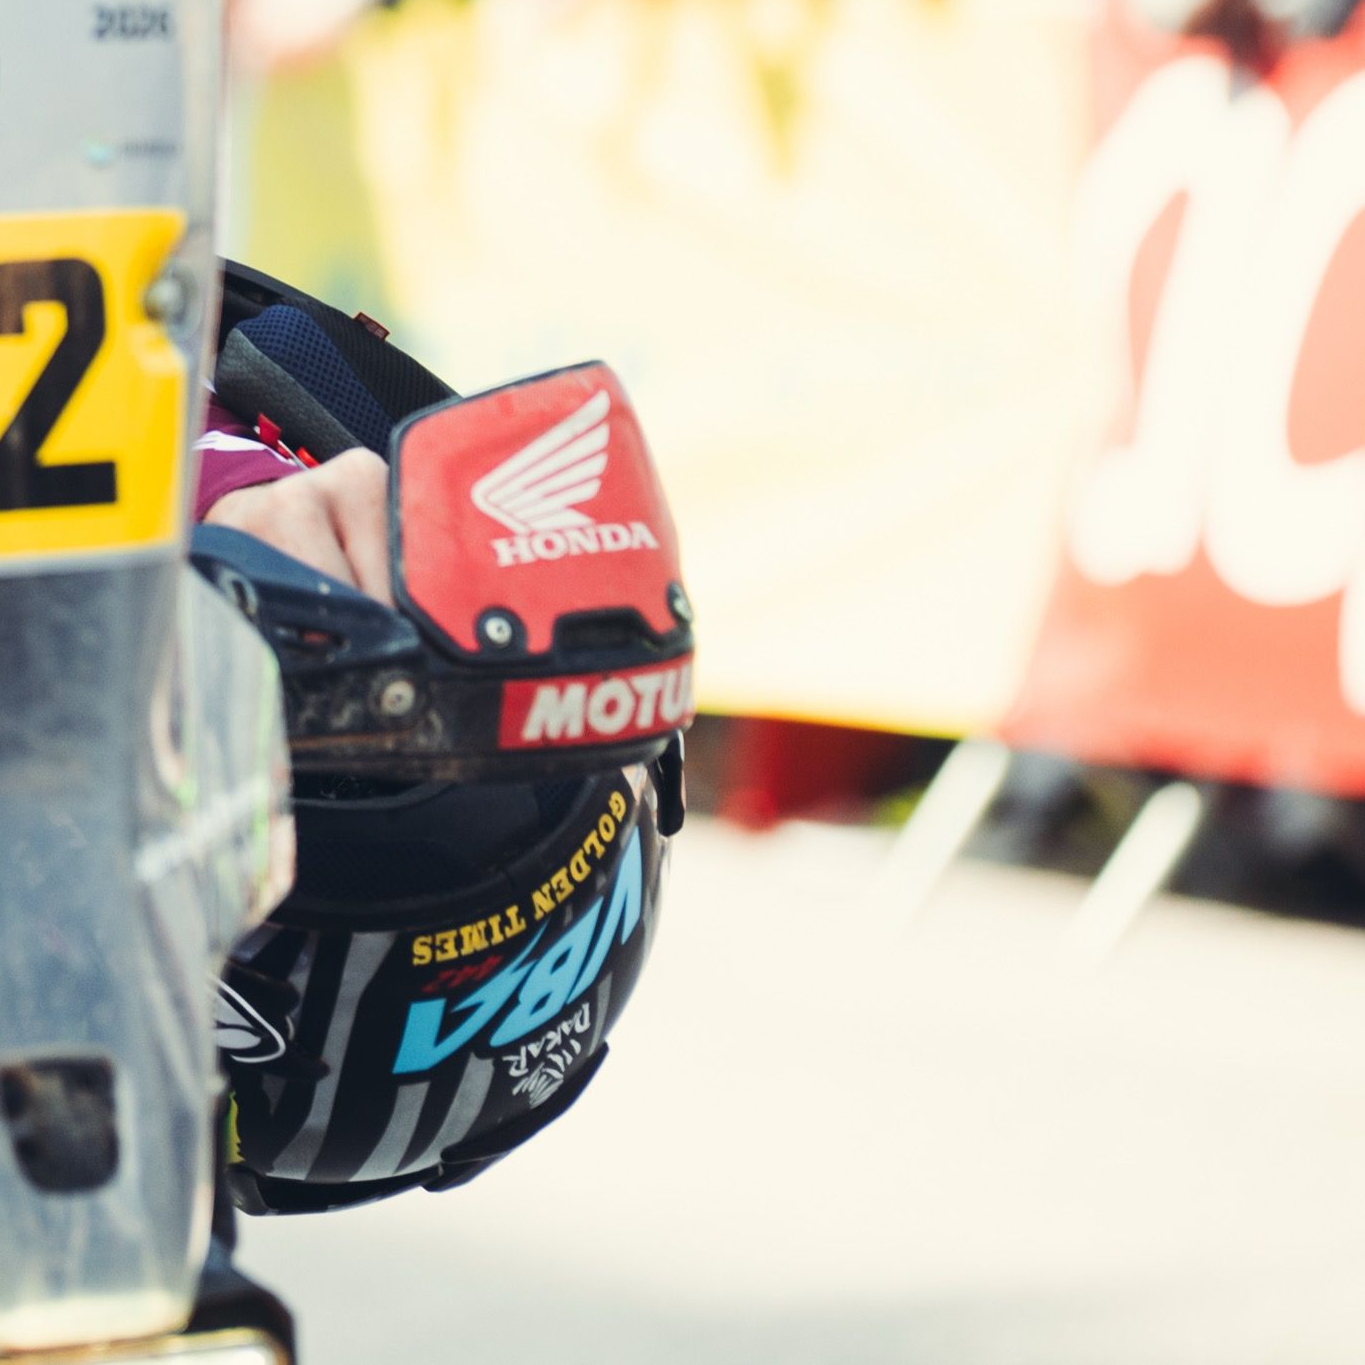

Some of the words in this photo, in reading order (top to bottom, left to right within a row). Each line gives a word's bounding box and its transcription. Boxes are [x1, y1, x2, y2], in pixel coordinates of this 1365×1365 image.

[493, 522, 659, 567] HONDA
[531, 791, 627, 921] GOLDEN
[411, 905, 527, 967] TIMES
[503, 1002, 590, 1077] DAKAR
